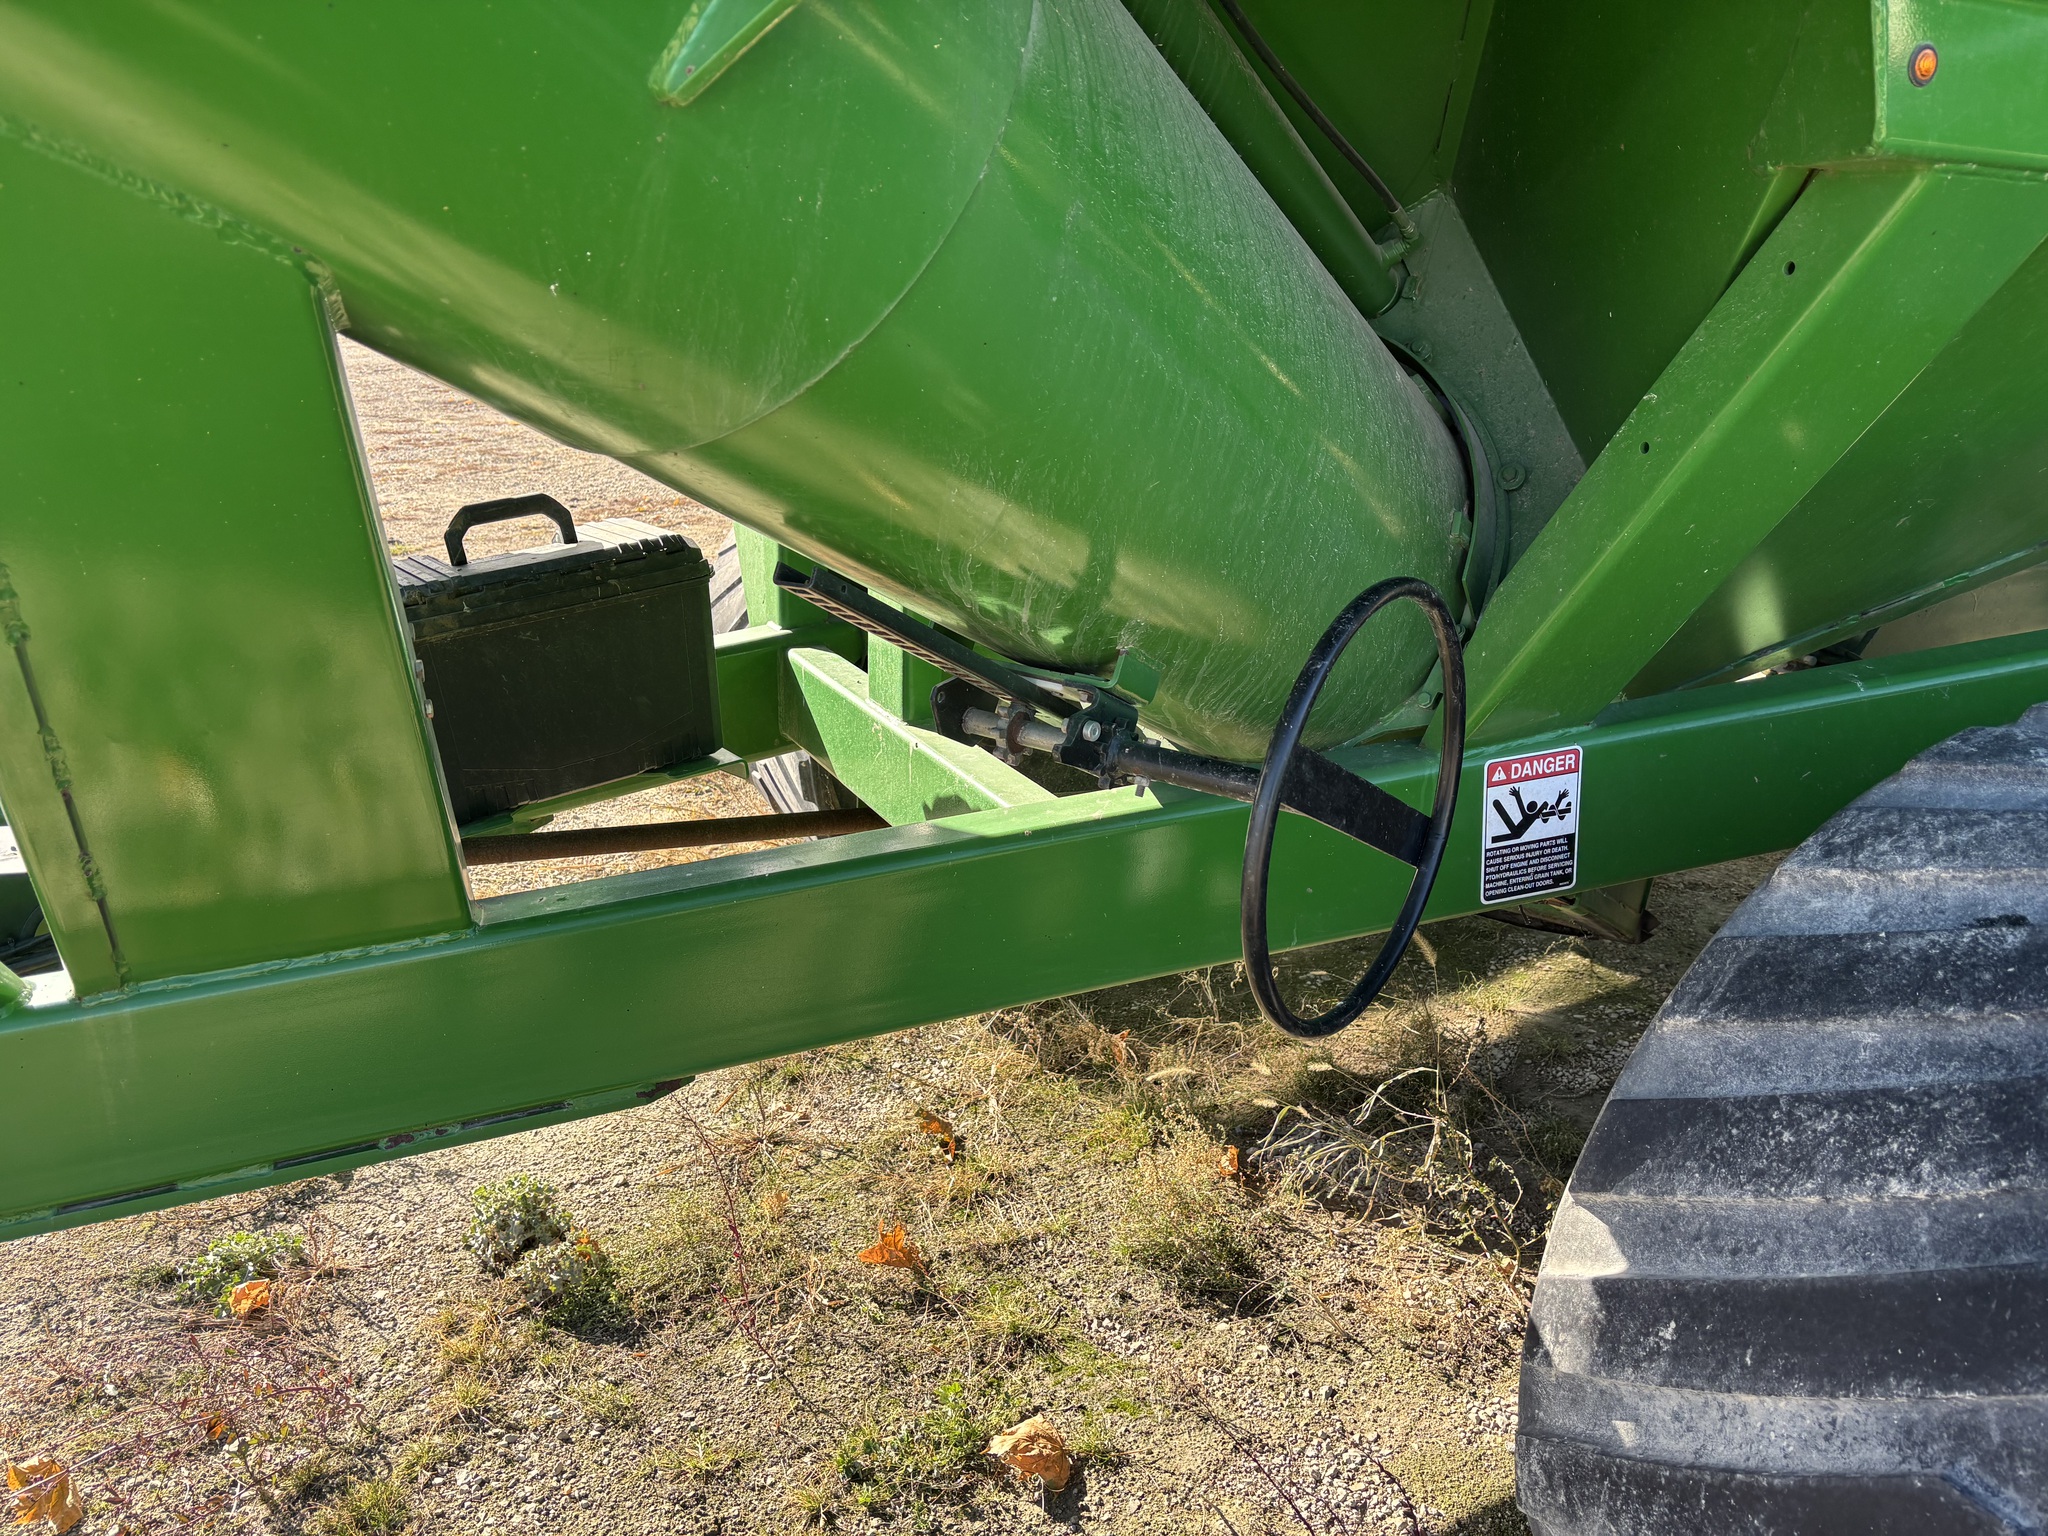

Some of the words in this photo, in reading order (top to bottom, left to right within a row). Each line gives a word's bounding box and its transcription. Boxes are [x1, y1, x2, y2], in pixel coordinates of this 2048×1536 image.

[1511, 754, 1575, 779] DANGER
[1486, 848, 1511, 857] ROTATING
[1520, 843, 1539, 851] MOVING
[1504, 853, 1525, 862] SERIOUS
[1526, 850, 1543, 858] INJURY
[1540, 853, 1570, 863] DISCONNECT
[1528, 865, 1547, 873] BEFORE
[1548, 860, 1573, 869] SERVICING
[1509, 875, 1533, 884] ENTERING
[1485, 887, 1507, 897] OPENING
[1508, 882, 1535, 892] CLEAN-OUT
